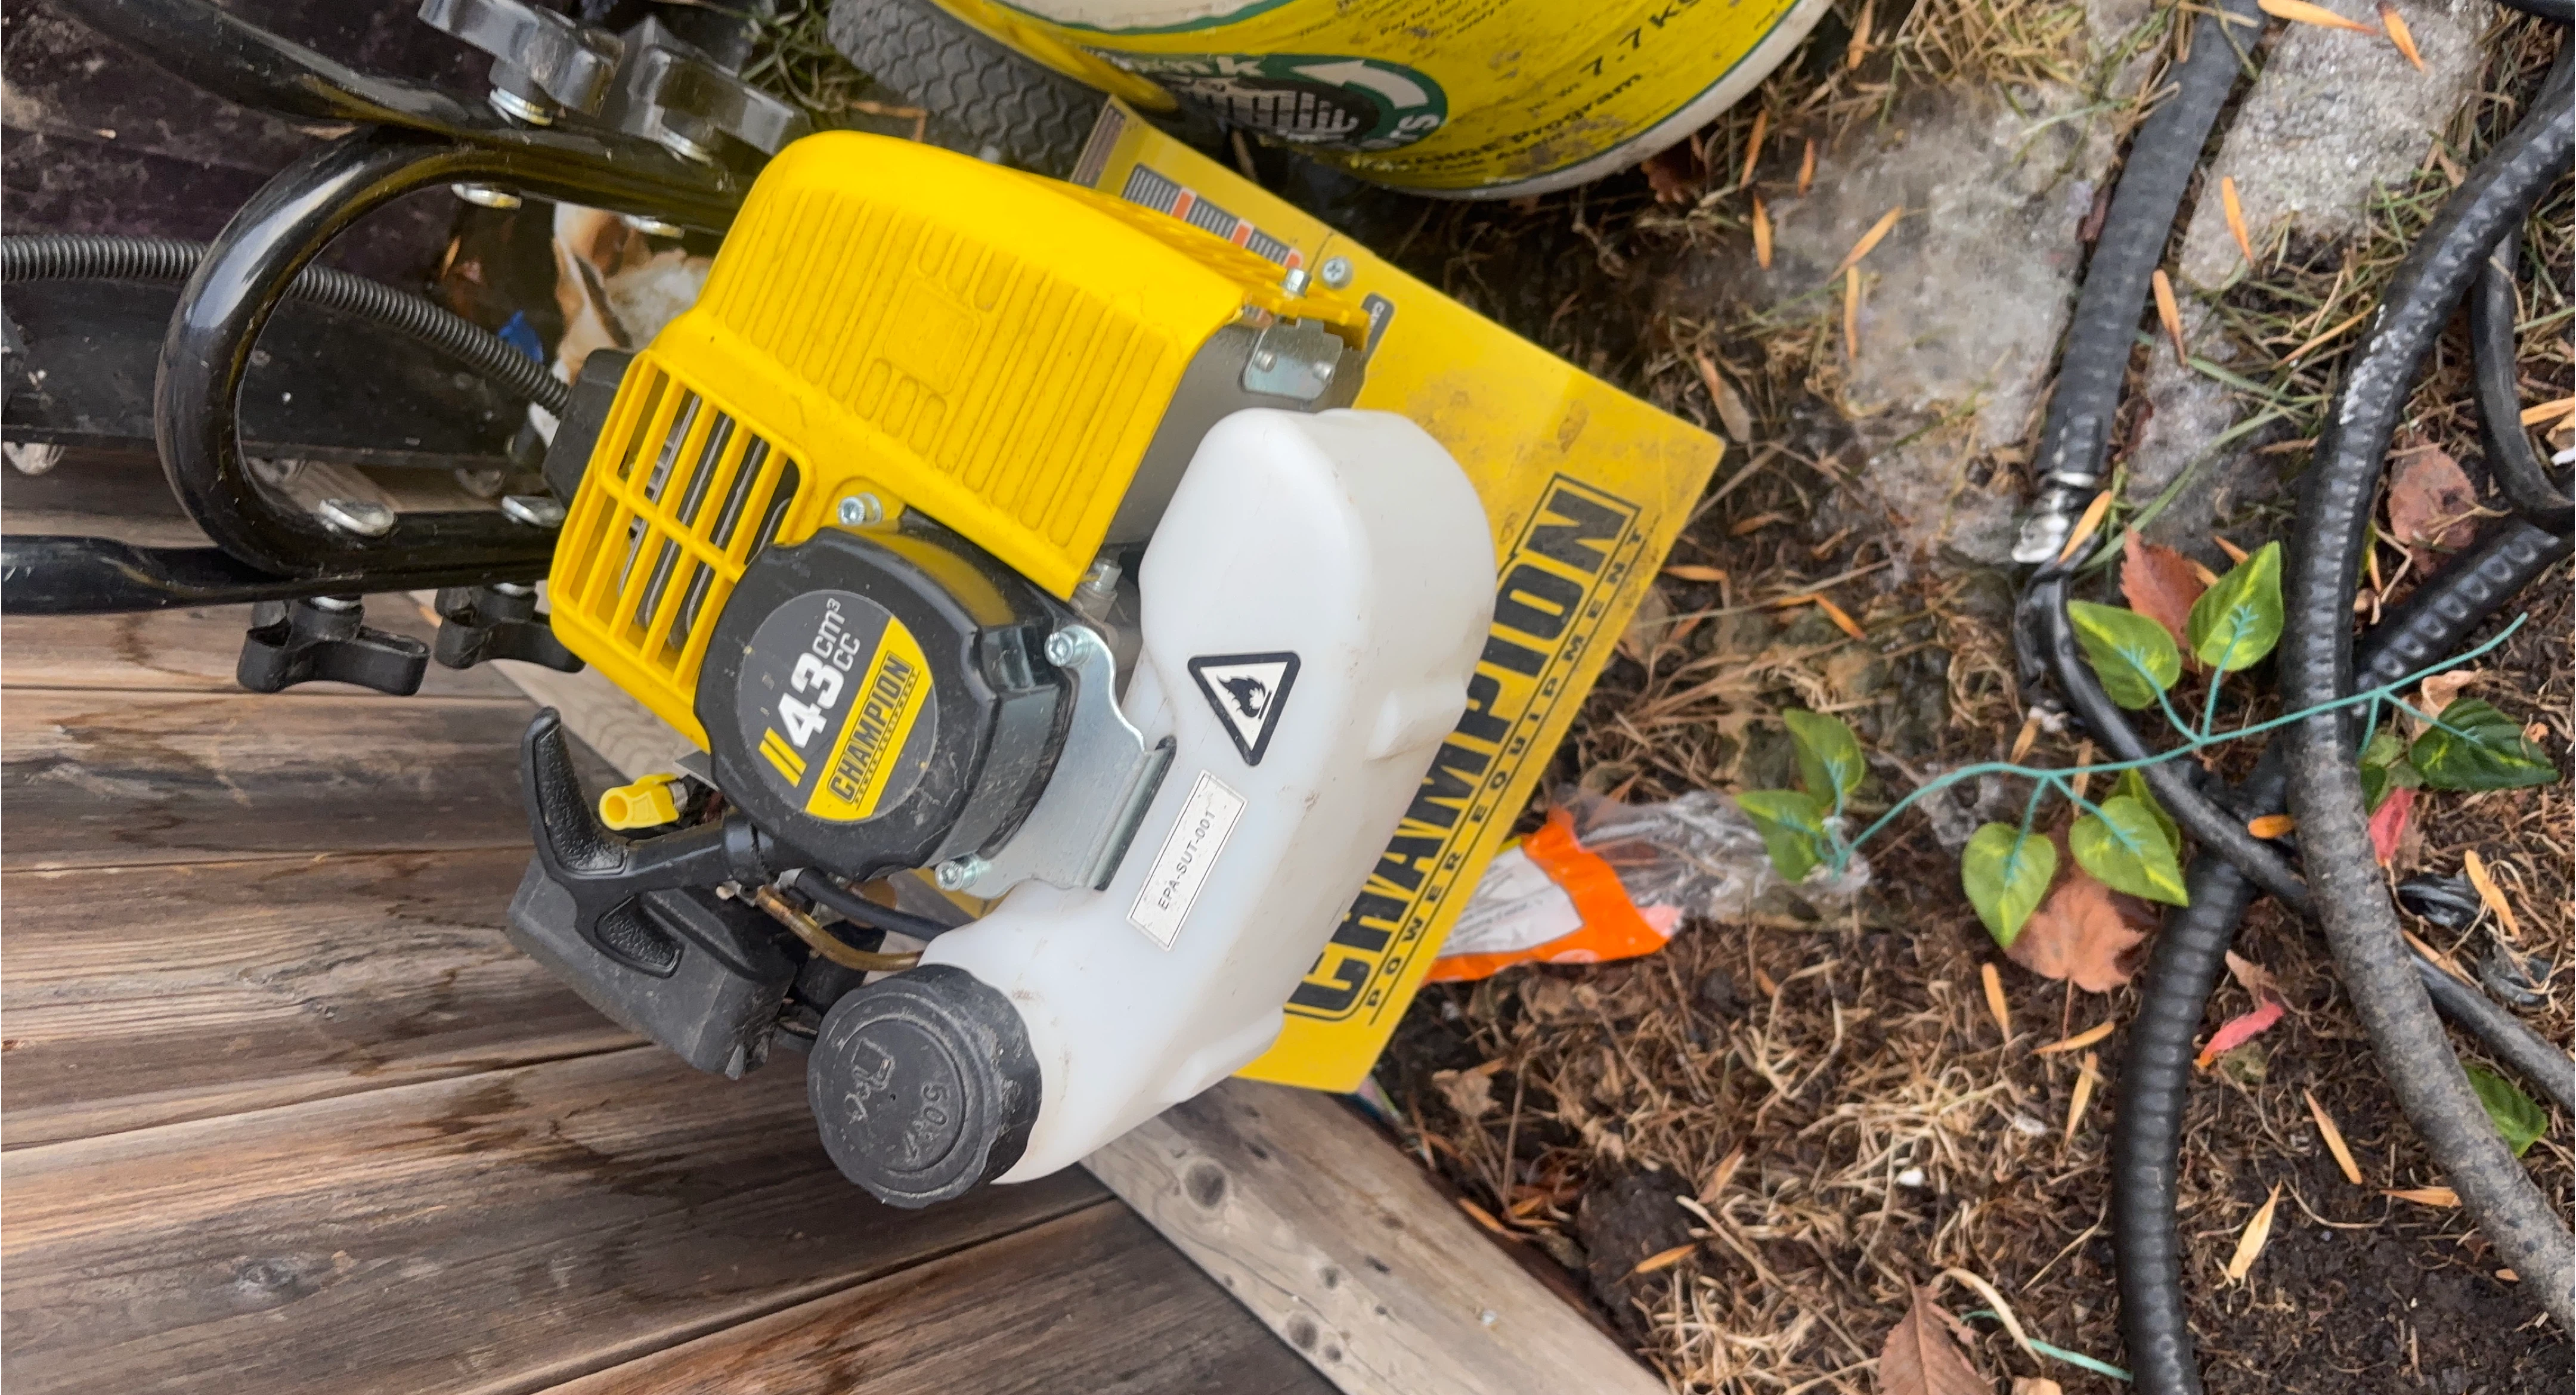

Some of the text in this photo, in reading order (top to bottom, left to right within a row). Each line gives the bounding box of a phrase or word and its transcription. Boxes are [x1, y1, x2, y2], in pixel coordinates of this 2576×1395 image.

[777, 651, 846, 749] 43
[829, 653, 912, 801] CHAMPION
[1292, 487, 1635, 1012] CHAMPION
[854, 758, 879, 805] POWER
[1366, 851, 1462, 1008] POWER
[1472, 527, 1645, 824] EQUIPMENT
[1157, 810, 1216, 912] EPA-SUT-001
